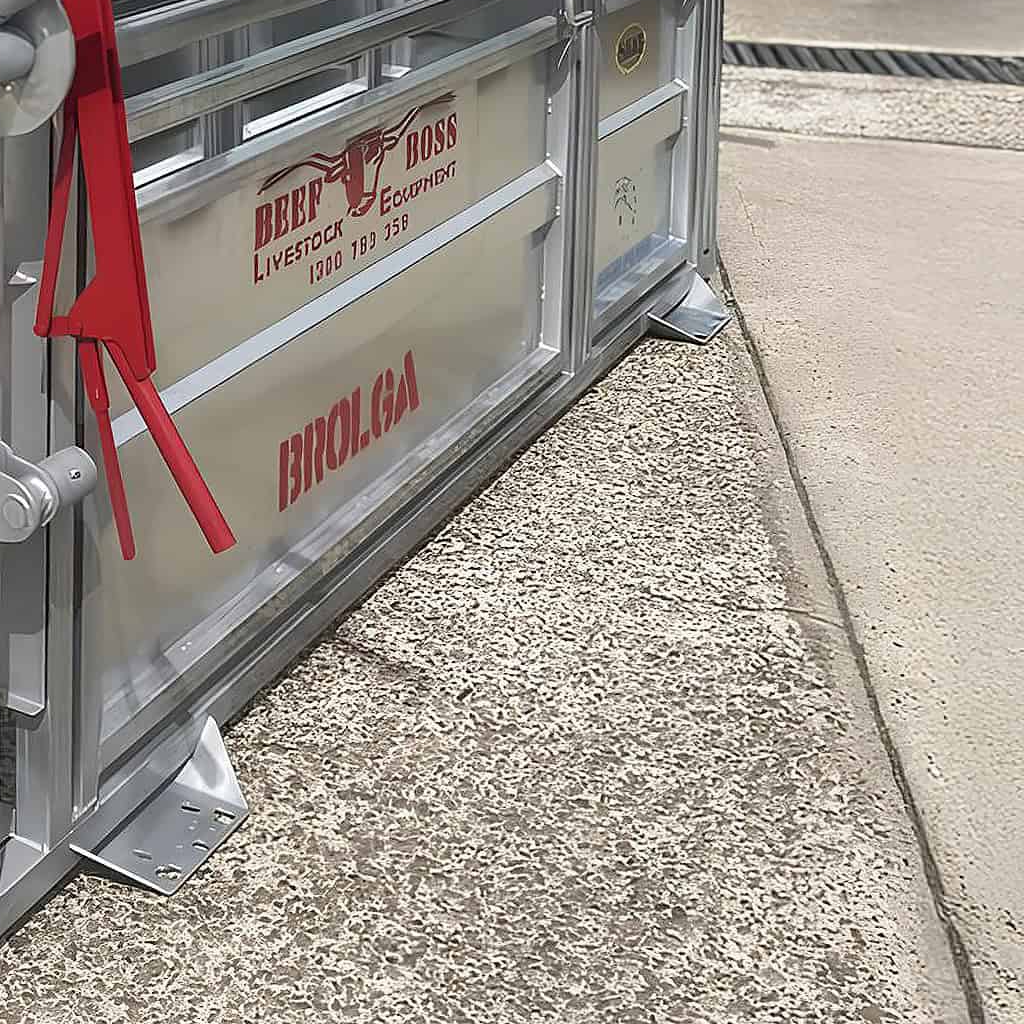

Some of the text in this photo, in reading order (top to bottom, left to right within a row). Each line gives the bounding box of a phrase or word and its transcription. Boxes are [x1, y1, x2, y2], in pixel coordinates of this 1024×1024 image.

[253, 112, 458, 251] BEEF BOSS
[253, 218, 344, 285] LIVESTOCK
[309, 250, 343, 285] 1300
[278, 349, 420, 513] BROLGA
